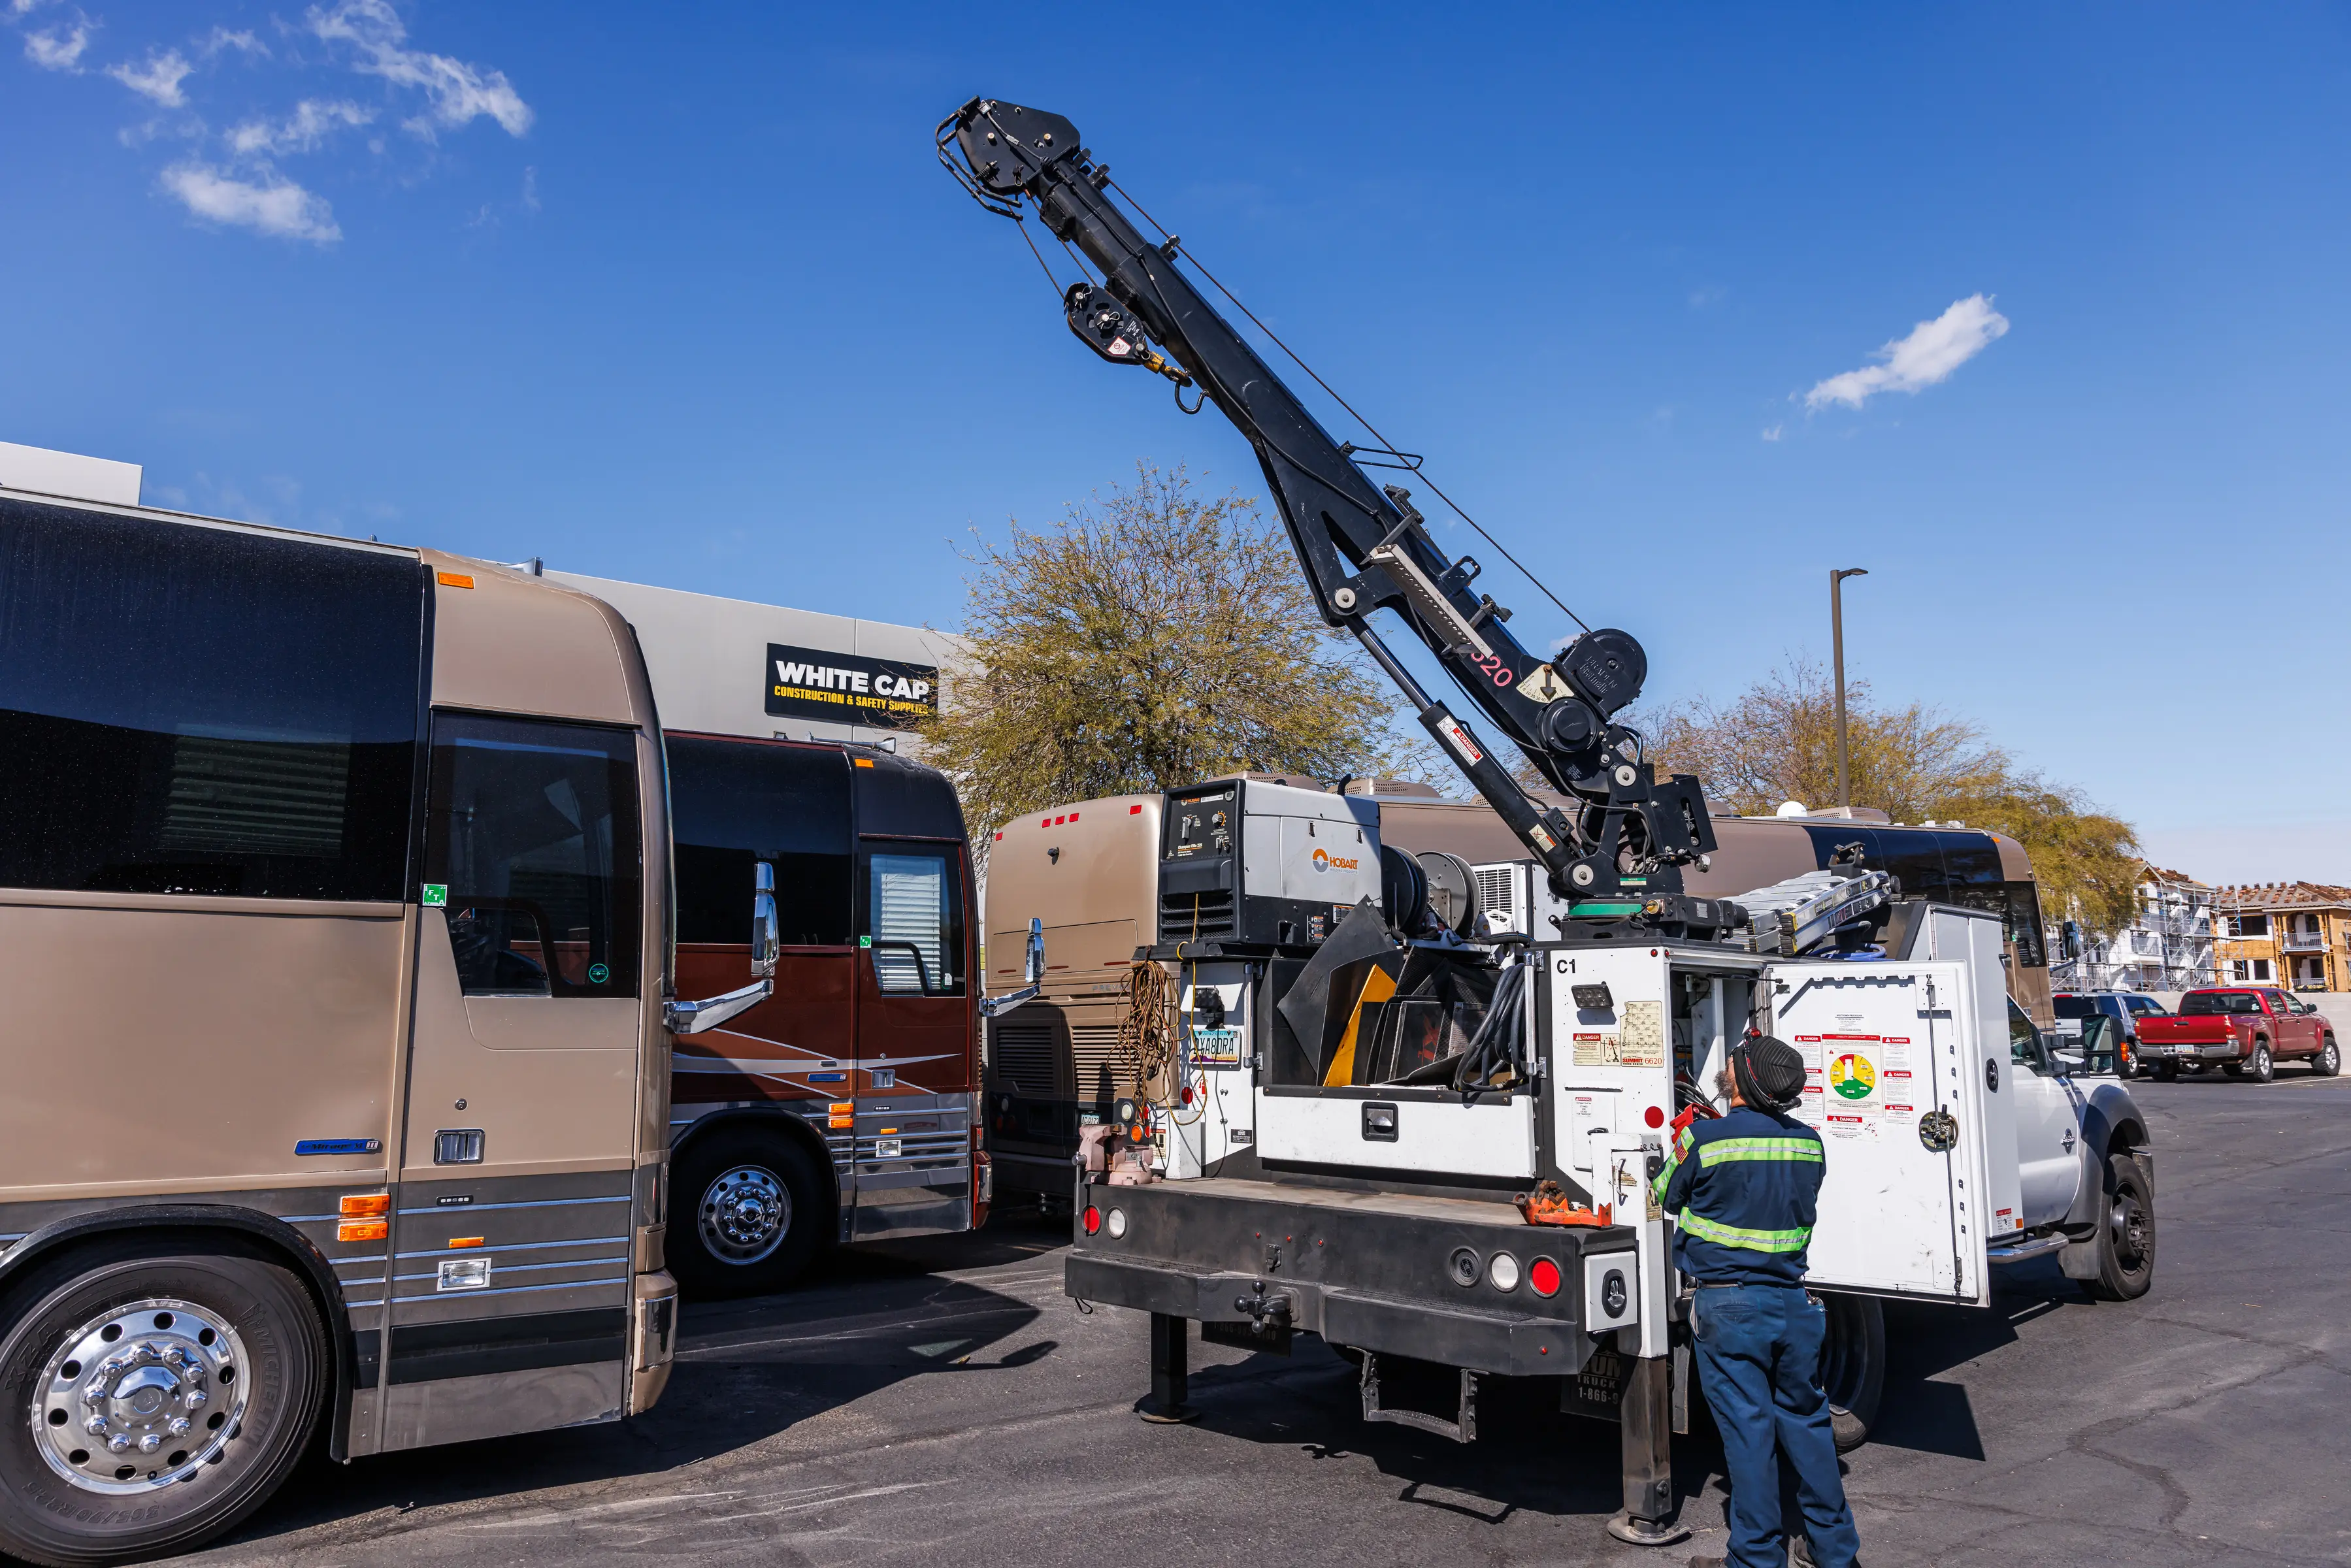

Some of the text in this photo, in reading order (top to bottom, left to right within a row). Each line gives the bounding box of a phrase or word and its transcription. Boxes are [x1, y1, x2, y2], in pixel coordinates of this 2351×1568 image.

[776, 661, 929, 700] WHITE CAP
[774, 685, 844, 704] CONSTRUCTION
[847, 695, 854, 705] &
[856, 696, 886, 710] SAFETY
[1460, 735, 1478, 757] DANGER
[1329, 857, 1358, 870] HOBART
[1557, 959, 1575, 974] C1
[244, 1329, 280, 1448] MICHELIN
[1577, 1374, 1616, 1389] TRUCK
